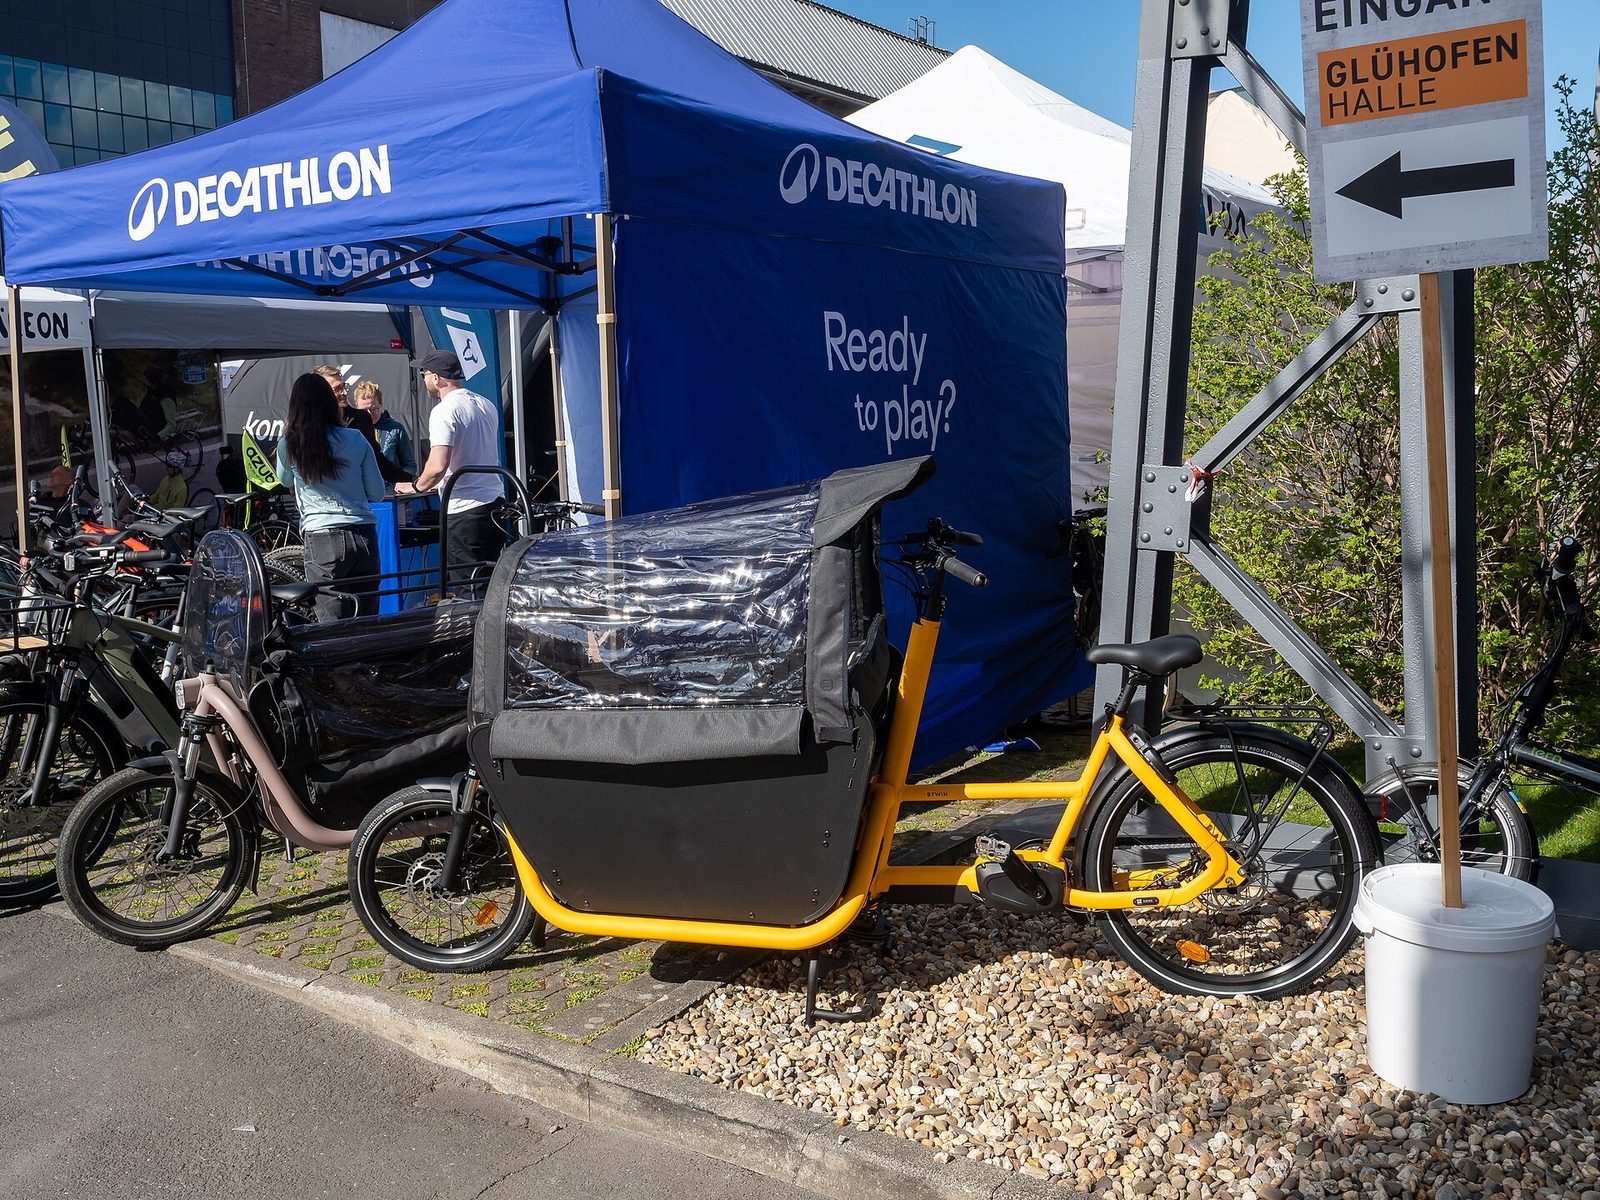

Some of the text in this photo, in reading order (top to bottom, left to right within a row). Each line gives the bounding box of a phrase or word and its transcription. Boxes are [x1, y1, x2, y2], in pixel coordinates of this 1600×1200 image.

[1326, 32, 1519, 88] GLÜHOFEN
[1328, 77, 1437, 119] HALLE
[173, 144, 392, 227] DECATHLON
[825, 156, 978, 227] DECATHLON
[823, 310, 928, 386] Ready
[854, 379, 957, 455] to play?
